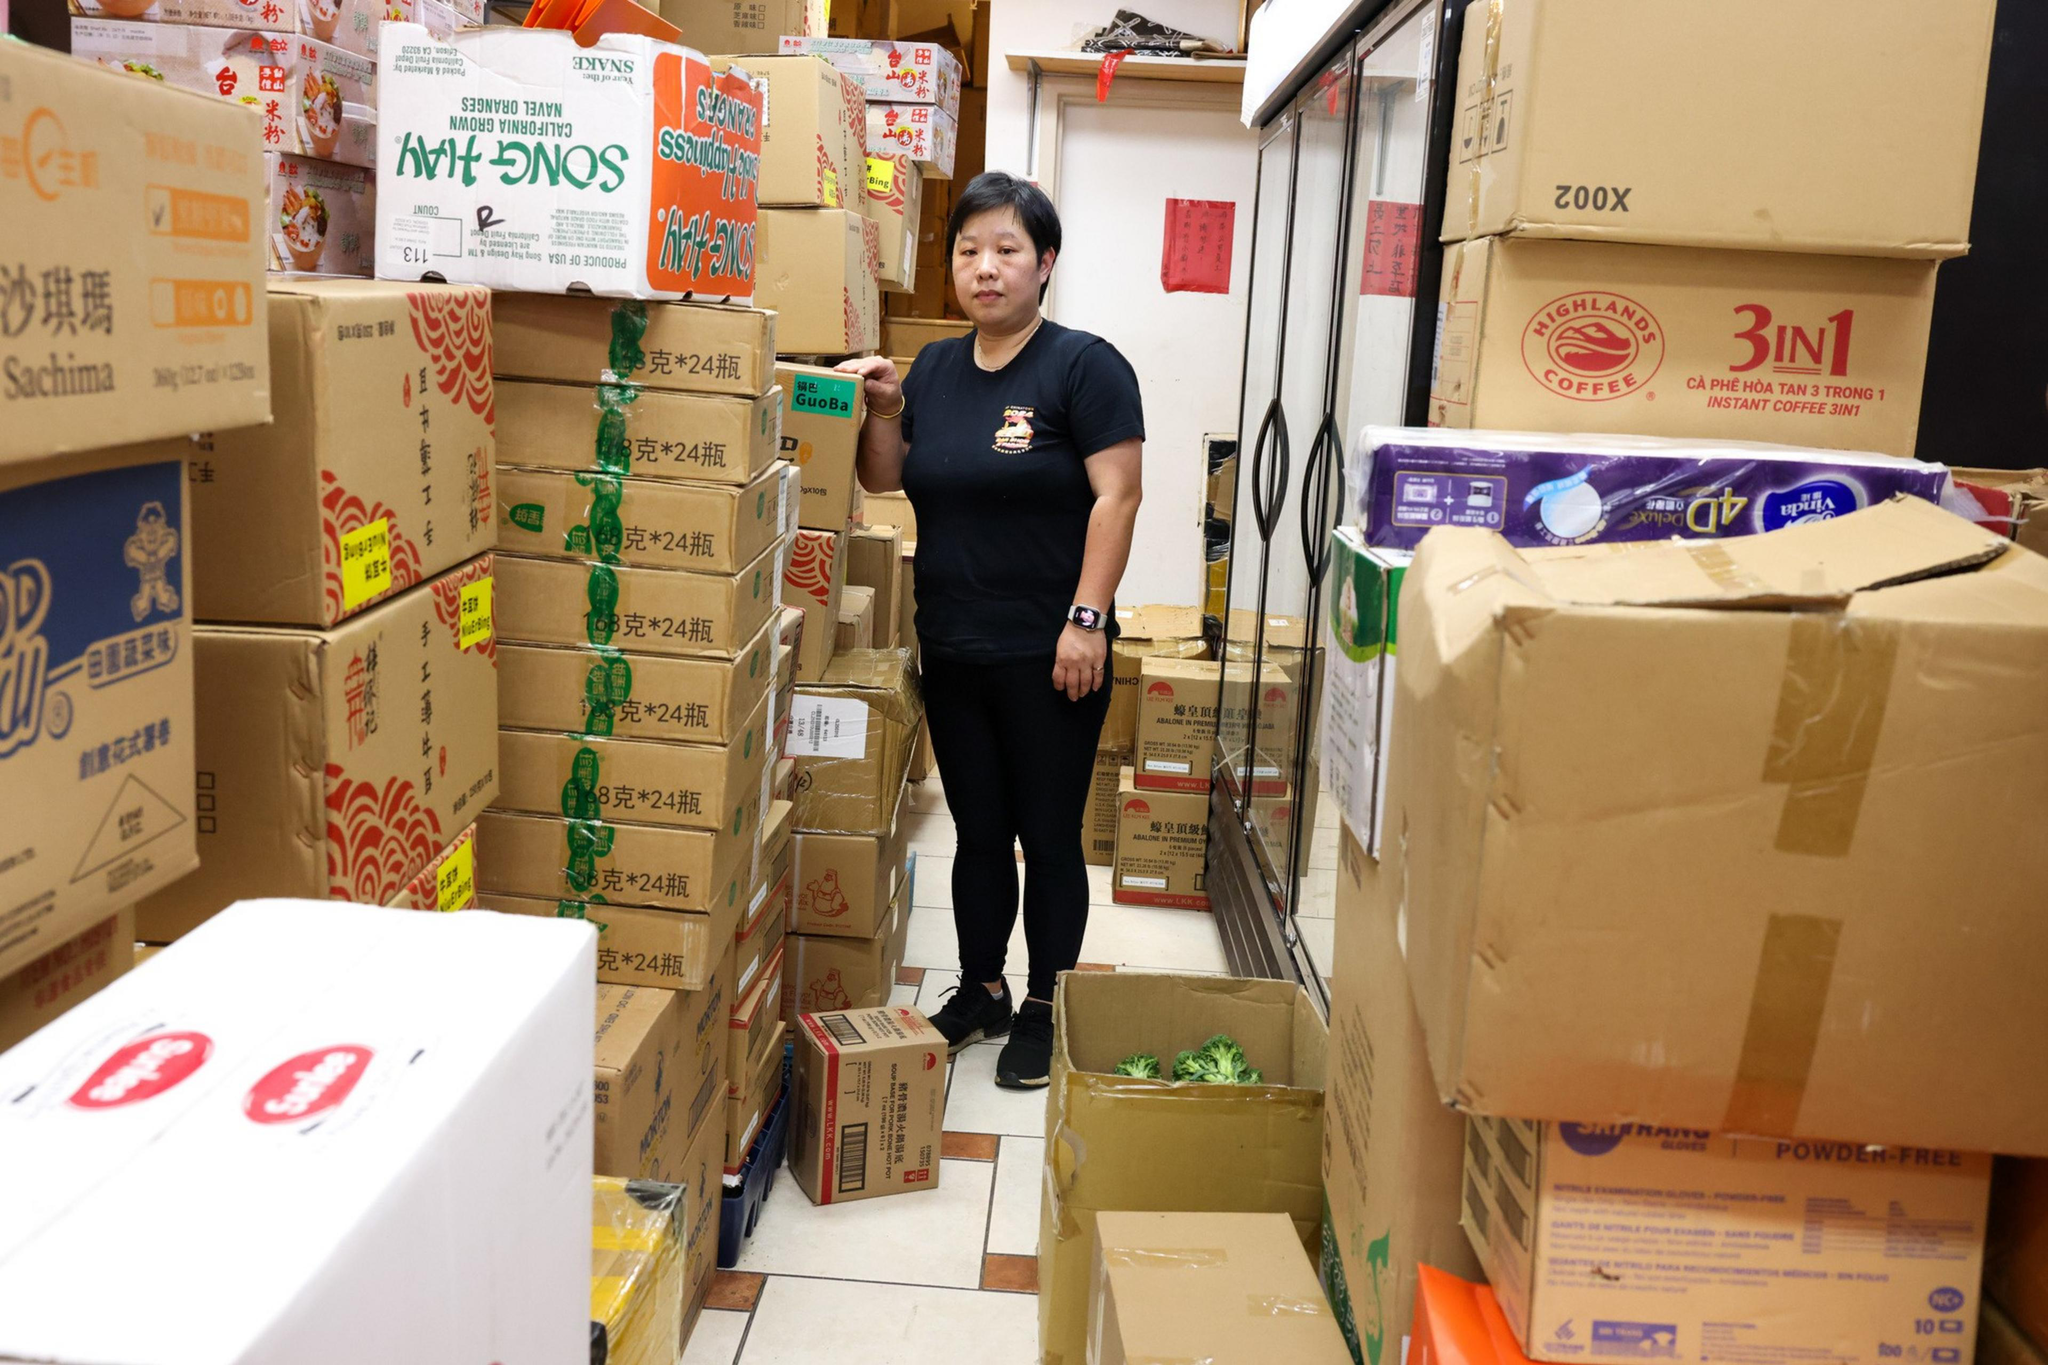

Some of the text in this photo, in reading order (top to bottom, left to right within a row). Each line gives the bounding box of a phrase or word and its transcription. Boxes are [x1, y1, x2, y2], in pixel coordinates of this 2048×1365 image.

[750, 3, 758, 12] 味
[395, 55, 463, 67] California Fruit Depot
[572, 56, 634, 74] SNAKE
[409, 65, 434, 75] Marketed
[444, 67, 466, 76] Packed
[599, 73, 611, 83] of
[612, 73, 633, 84] Year
[461, 97, 562, 117] NAVEL ORANGES
[263, 99, 285, 145] 米粉
[449, 115, 573, 138] CALIFORNIA GROWN
[396, 131, 629, 194] SONG HAY
[658, 126, 739, 201] Happiness
[1553, 184, 1633, 213] X002
[413, 204, 439, 216] COUNT
[490, 230, 506, 240] Fruit
[507, 231, 539, 242] California
[658, 205, 757, 282] SONG HAY
[488, 240, 518, 249] Licensed
[404, 246, 428, 263] 113
[487, 249, 509, 259] Design
[511, 252, 524, 260] Hay
[525, 253, 541, 261] Song
[548, 253, 627, 269] PRODUCE OF USA
[1532, 297, 1657, 347] HIGHLANDS
[1728, 303, 1855, 379] 3IN1
[3, 353, 115, 400] Sachima
[1542, 370, 1640, 397] COFFEE
[1686, 375, 1886, 401] CÀ PHÊ HÒA TAN 3 TRONG 1
[795, 393, 849, 411] GuoBa
[1707, 396, 1861, 417] INSTANT COFFEE 3IN1
[1686, 487, 1749, 534] 4D
[1781, 496, 1836, 517] Vinda
[1629, 510, 1685, 527] Deluxe
[1113, 676, 1139, 686] CHIN
[1156, 717, 1184, 725] ABALONE
[1133, 834, 1160, 842] ABALONE
[1169, 836, 1197, 844] PREMIUM
[888, 1100, 896, 1113] FOR
[825, 1099, 835, 1160] www.LKK.com
[887, 1115, 895, 1132] PORK
[1661, 1140, 1707, 1151] GLOVES
[1776, 1141, 1962, 1167] POWDER-FREE
[1553, 1183, 1592, 1195] NITRILE
[1594, 1185, 1663, 1198] EXAMINATION
[1665, 1188, 1705, 1200] GLOVES
[1604, 1222, 1641, 1234] NITRILE
[1914, 1319, 1935, 1334] 10
